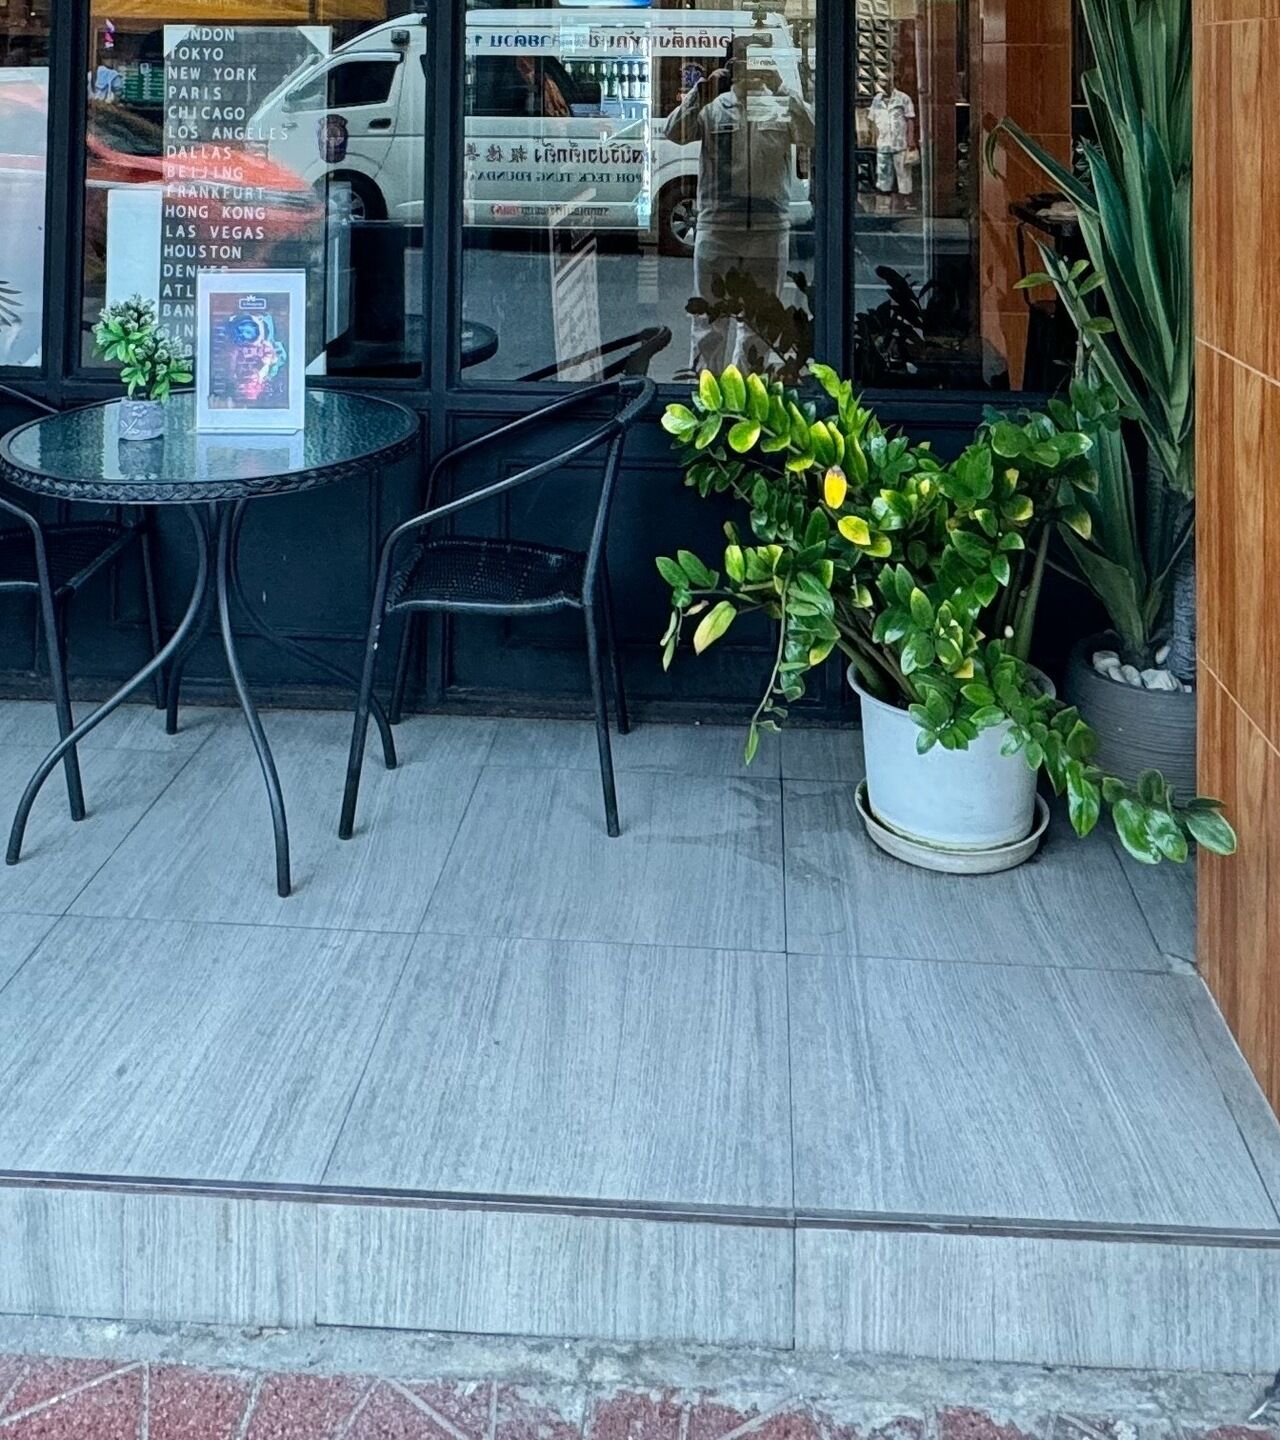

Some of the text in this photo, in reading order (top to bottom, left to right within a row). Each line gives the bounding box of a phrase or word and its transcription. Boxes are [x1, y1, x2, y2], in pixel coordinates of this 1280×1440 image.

[183, 28, 235, 41] NDON
[170, 47, 224, 61] TOKYO
[167, 66, 257, 81] NEW YORK
[167, 86, 222, 100] PARIS
[167, 105, 246, 120] CHICAGO
[168, 125, 289, 140] LOS ANGELES
[166, 146, 232, 160] DALLAS
[166, 186, 265, 200] FRANKFURT
[165, 205, 266, 220] HONG KONG
[165, 225, 265, 240] LAS VEGAS
[163, 245, 242, 259] HOUSTON
